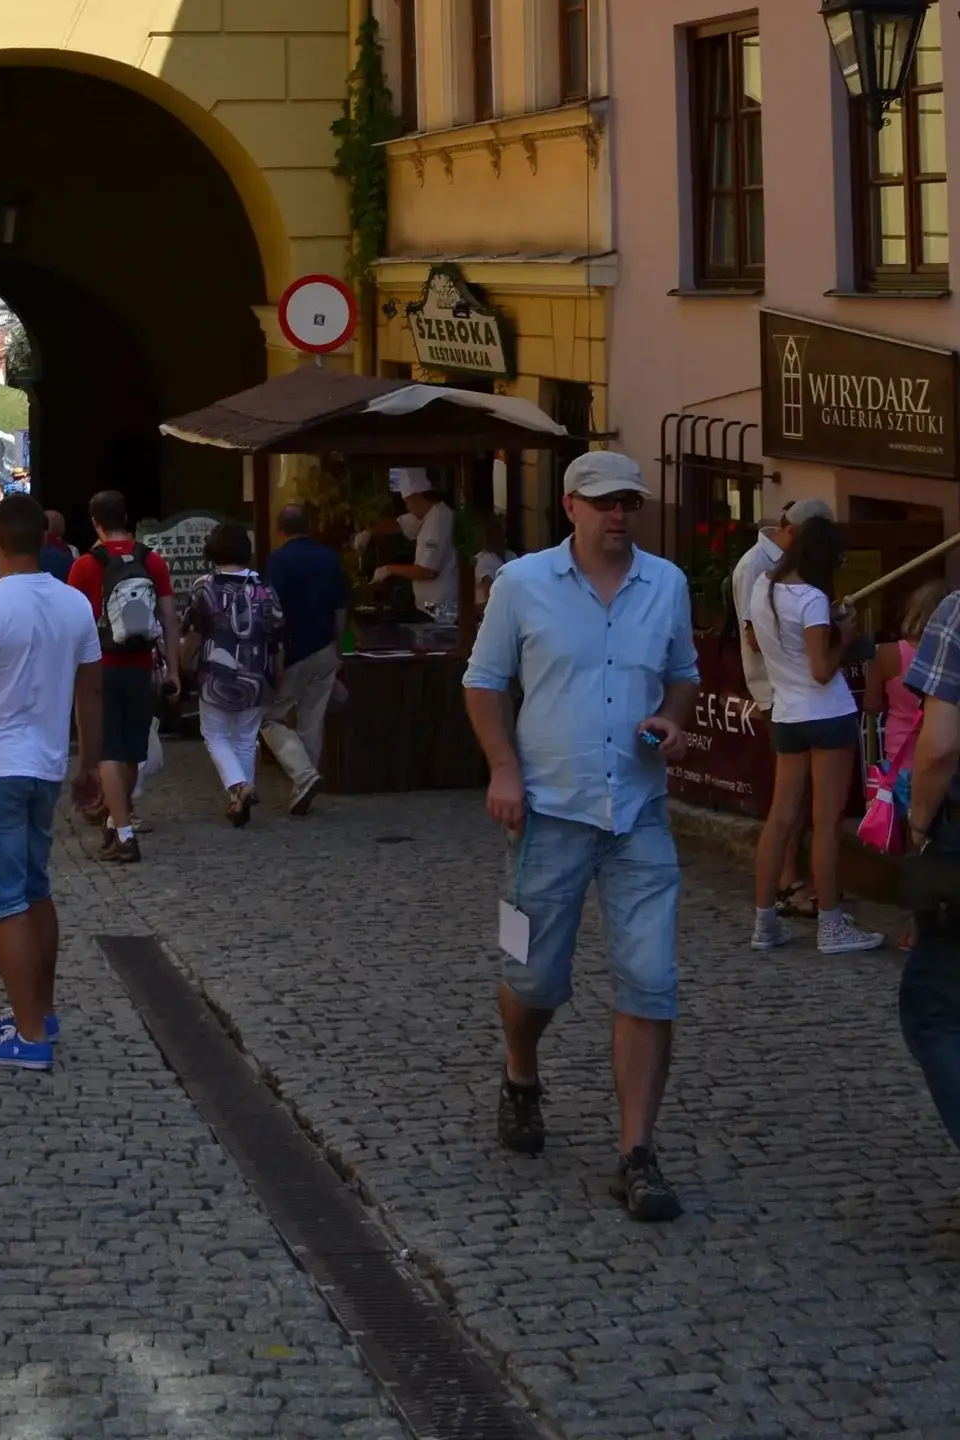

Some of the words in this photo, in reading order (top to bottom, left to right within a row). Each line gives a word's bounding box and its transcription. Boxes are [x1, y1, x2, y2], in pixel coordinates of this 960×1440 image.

[416, 317, 497, 346] SZEROKA
[428, 346, 492, 367] RESTAURACJA
[808, 373, 931, 414] WIRYDARZ
[821, 408, 883, 430] GALERIA
[887, 413, 944, 435] SZTUKI
[683, 731, 713, 751] BRAZY
